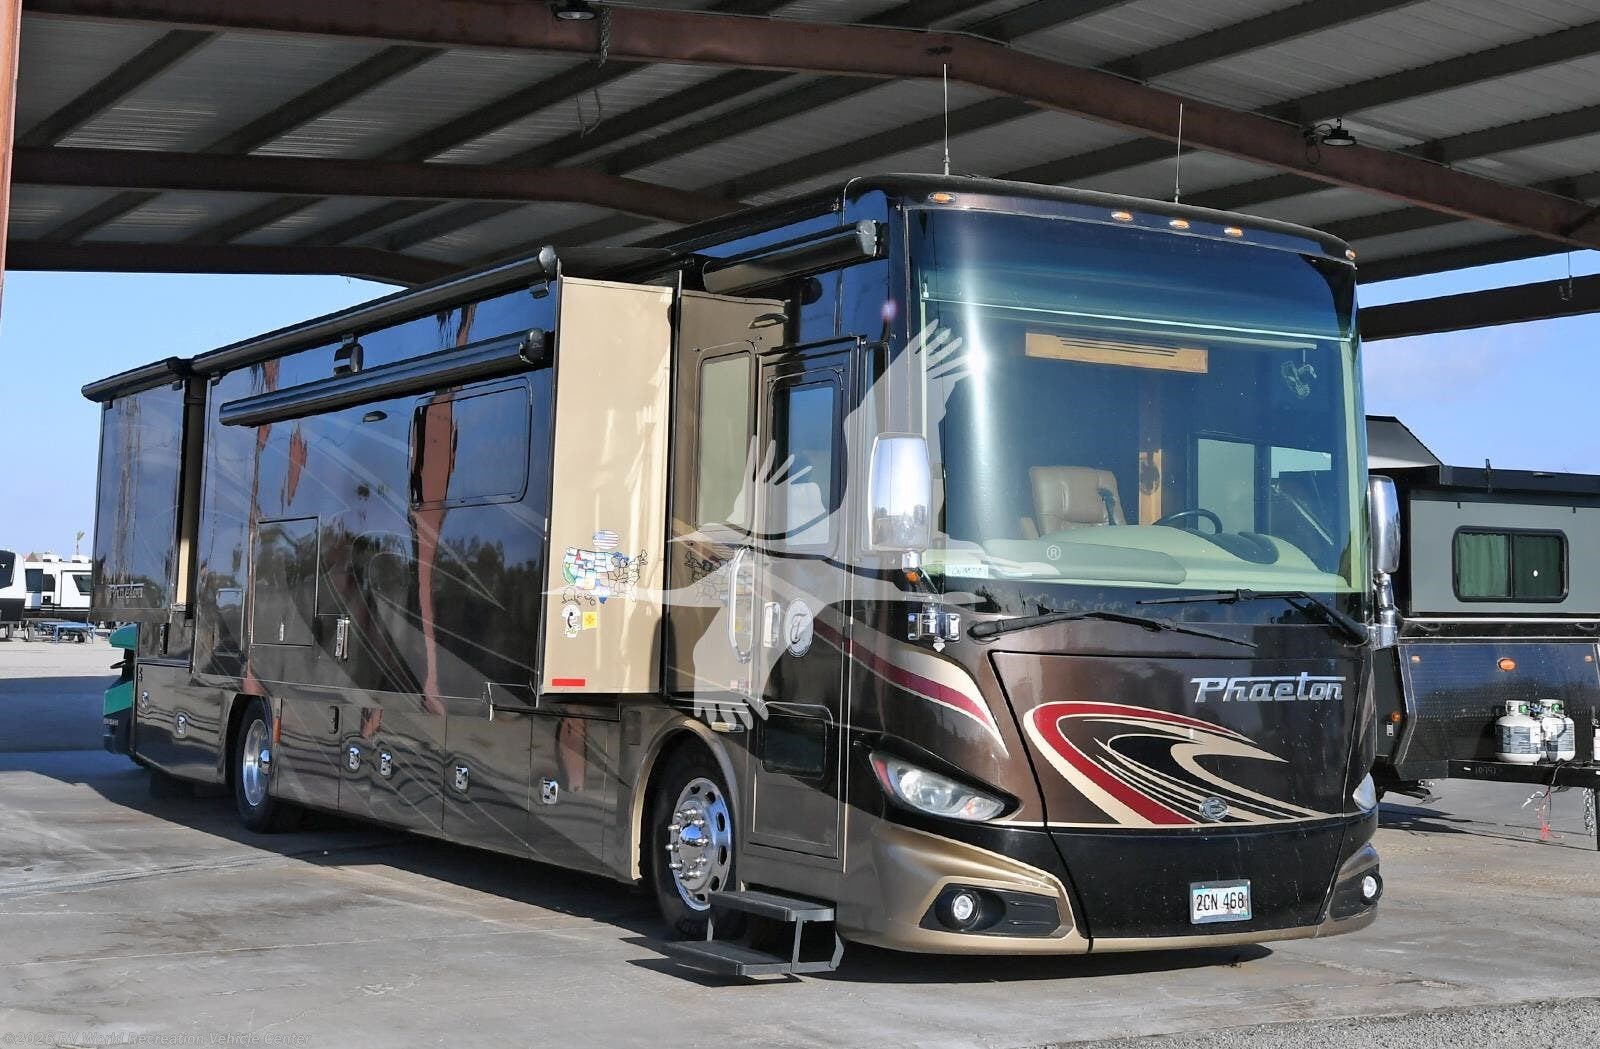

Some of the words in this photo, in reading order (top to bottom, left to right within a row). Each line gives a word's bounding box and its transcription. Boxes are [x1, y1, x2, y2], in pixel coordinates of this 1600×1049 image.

[1189, 671, 1347, 703] Phaeton
[1196, 893, 1218, 911] 2CN
[1223, 891, 1244, 910] 468
